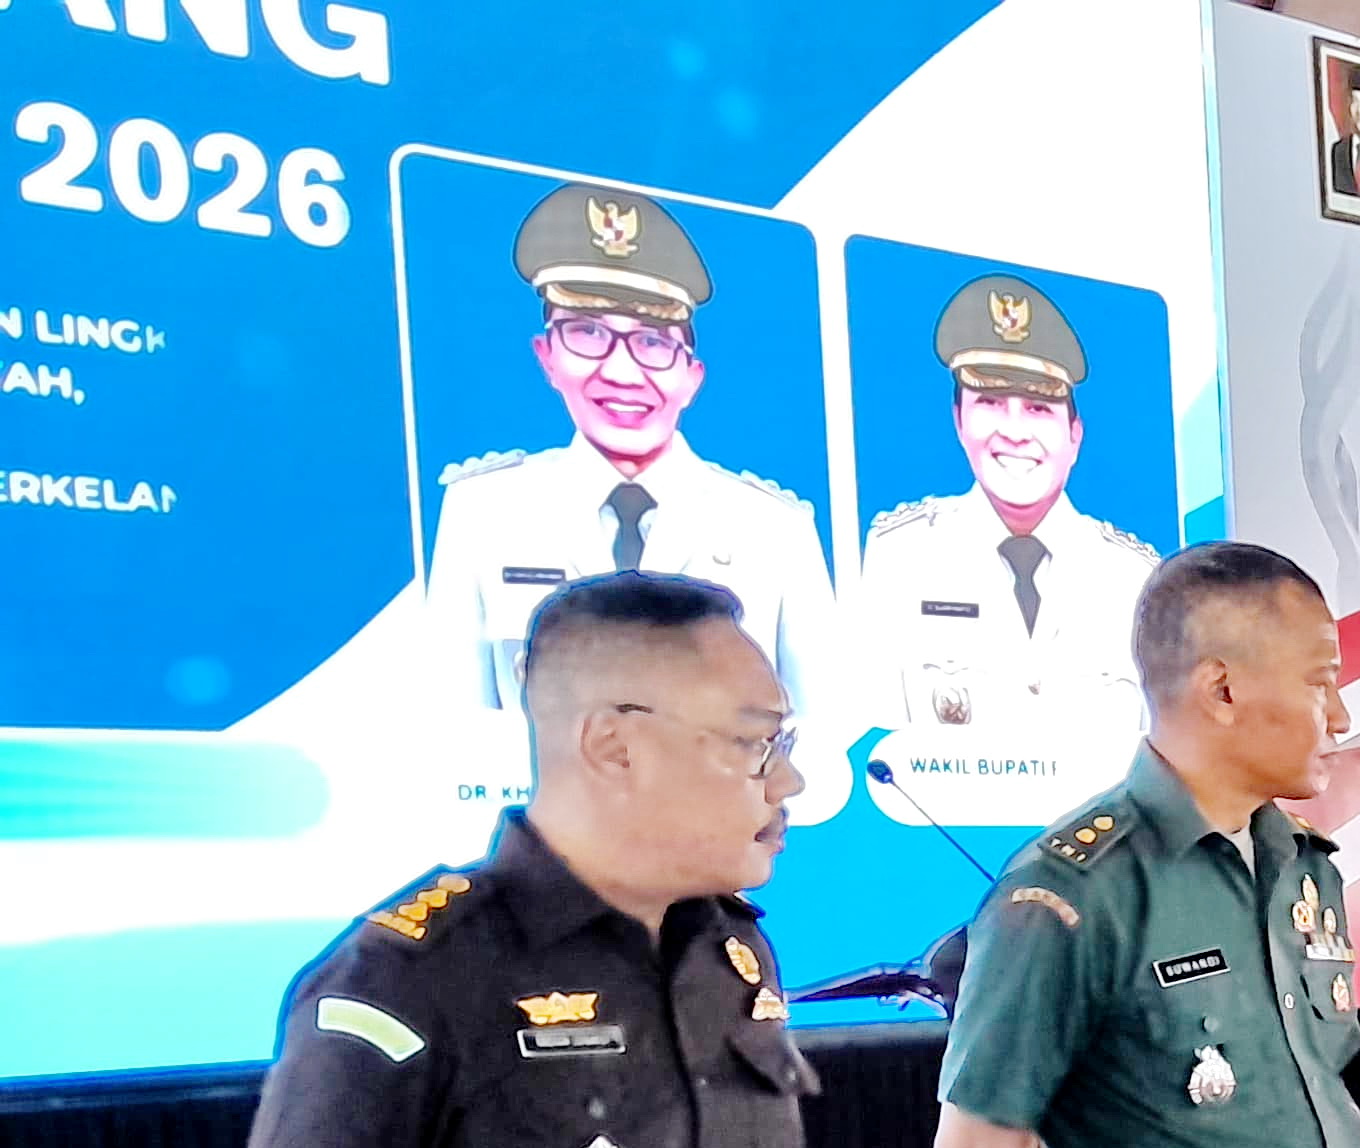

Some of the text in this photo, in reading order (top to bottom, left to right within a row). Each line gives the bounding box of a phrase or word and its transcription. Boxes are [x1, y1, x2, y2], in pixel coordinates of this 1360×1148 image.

[14, 100, 351, 248] 2026
[0, 361, 86, 406] AH,
[0, 470, 177, 514] RKELA
[910, 757, 971, 775] WAKIL
[977, 758, 1046, 777] BUPATI
